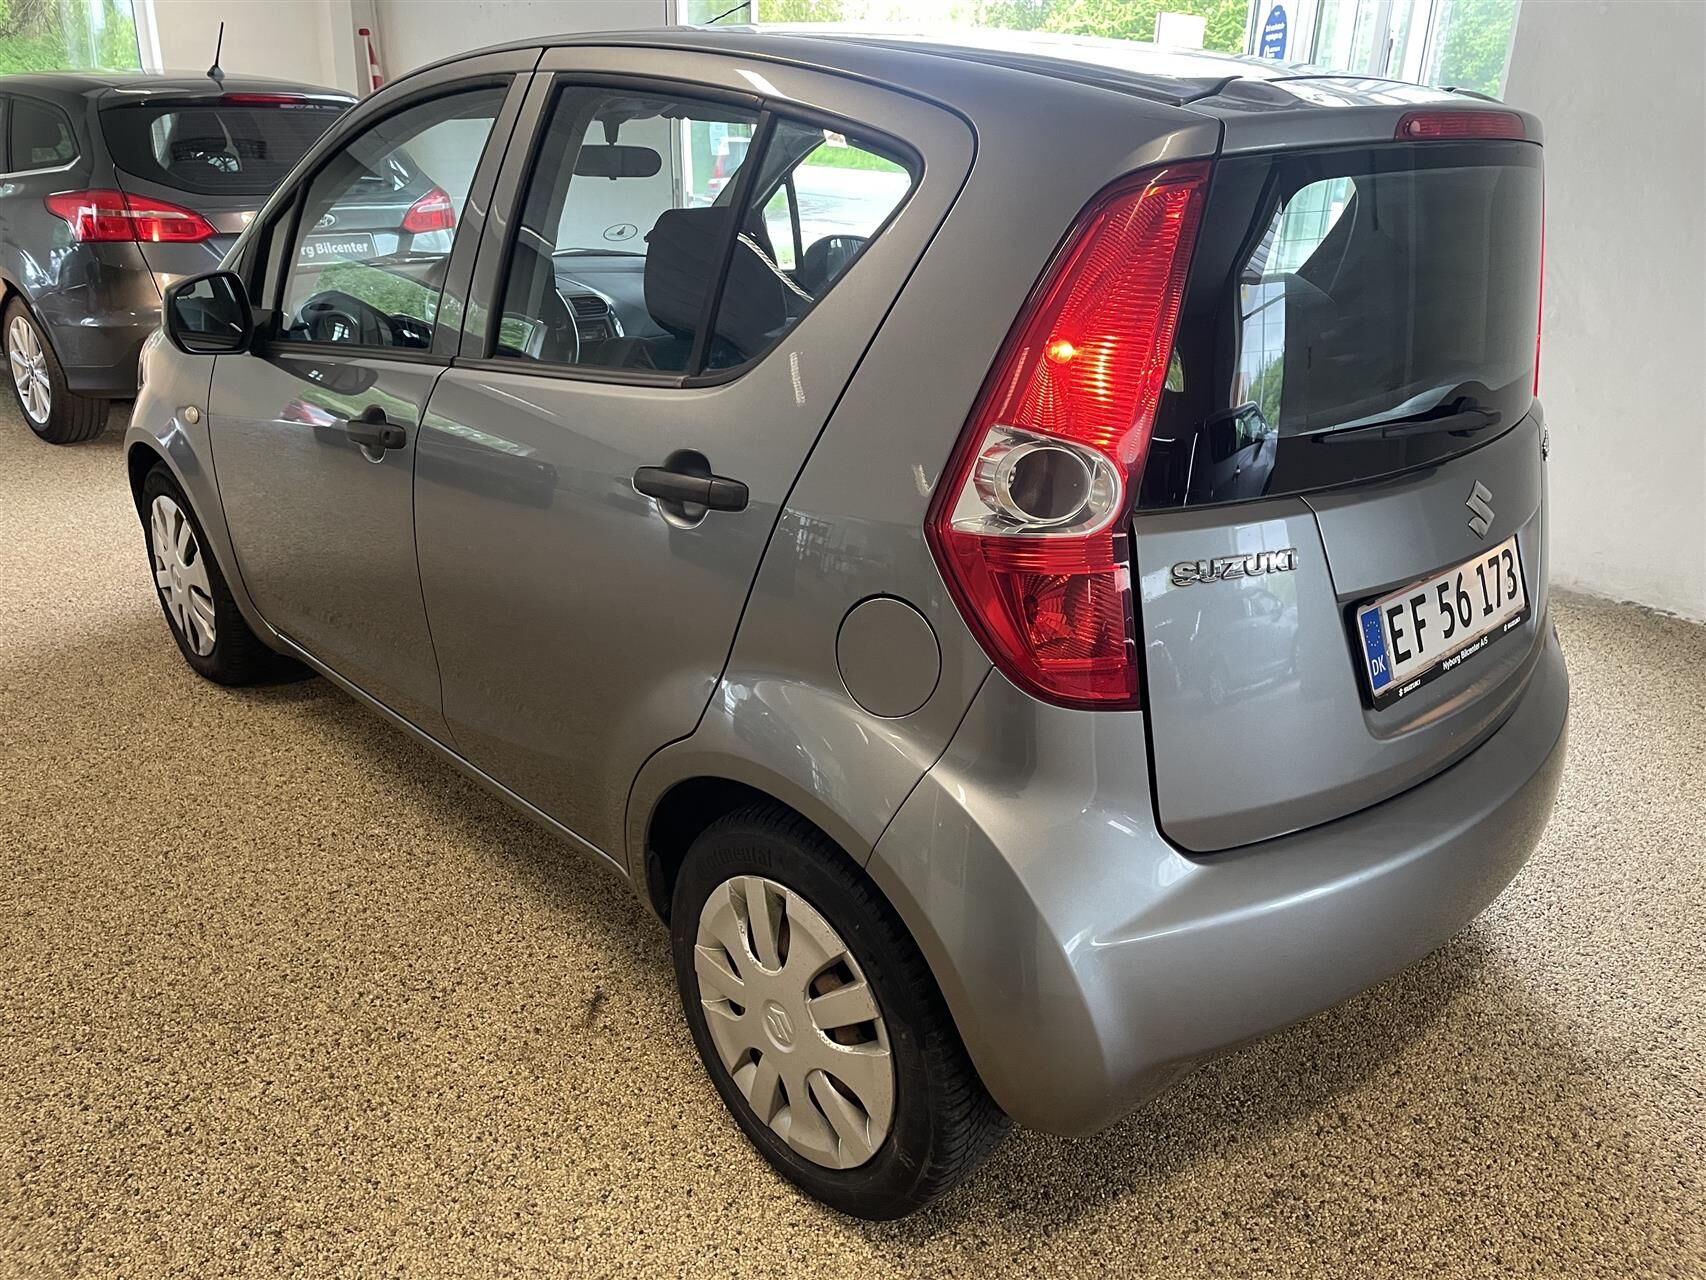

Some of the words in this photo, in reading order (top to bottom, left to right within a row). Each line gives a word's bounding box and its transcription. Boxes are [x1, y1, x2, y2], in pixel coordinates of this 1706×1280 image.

[315, 241, 368, 255] Bilcenter
[1171, 548, 1298, 586] SUZUKI
[1386, 593, 1426, 665] EF
[1436, 571, 1472, 639] 56
[1476, 549, 1517, 617] 173
[1371, 654, 1387, 677] DK
[1442, 655, 1461, 671] Nyborg
[1460, 641, 1481, 659] Bilcenter
[1480, 636, 1489, 648] A/S
